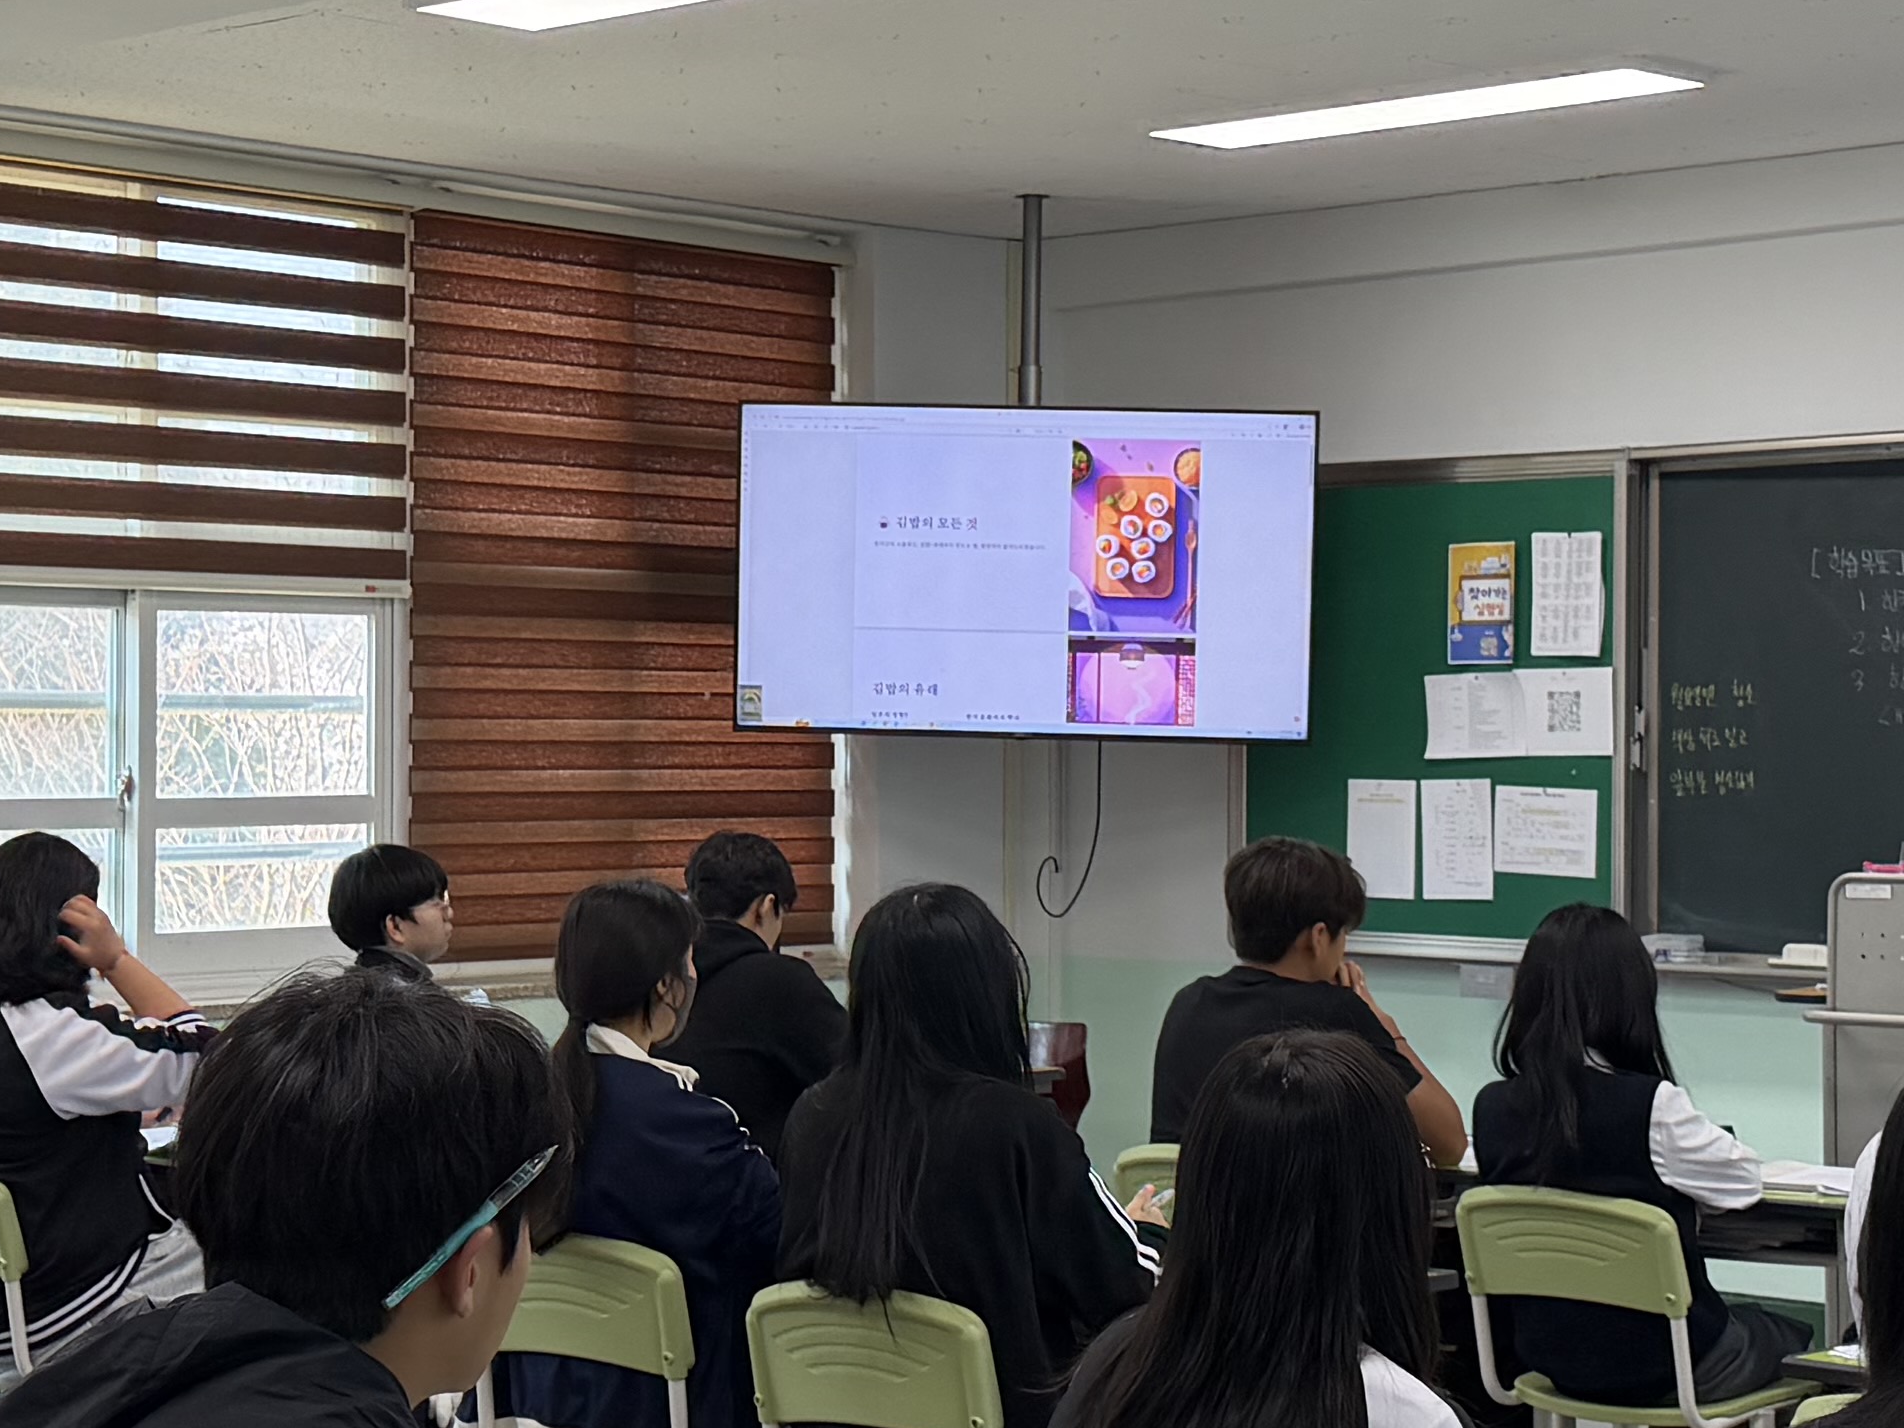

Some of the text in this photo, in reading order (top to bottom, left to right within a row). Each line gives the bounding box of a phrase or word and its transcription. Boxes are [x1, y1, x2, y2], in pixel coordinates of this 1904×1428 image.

[896, 516, 978, 531] 김밥의 모든 것
[1468, 586, 1508, 601] 찾아가는
[872, 681, 910, 696] 김밥의
